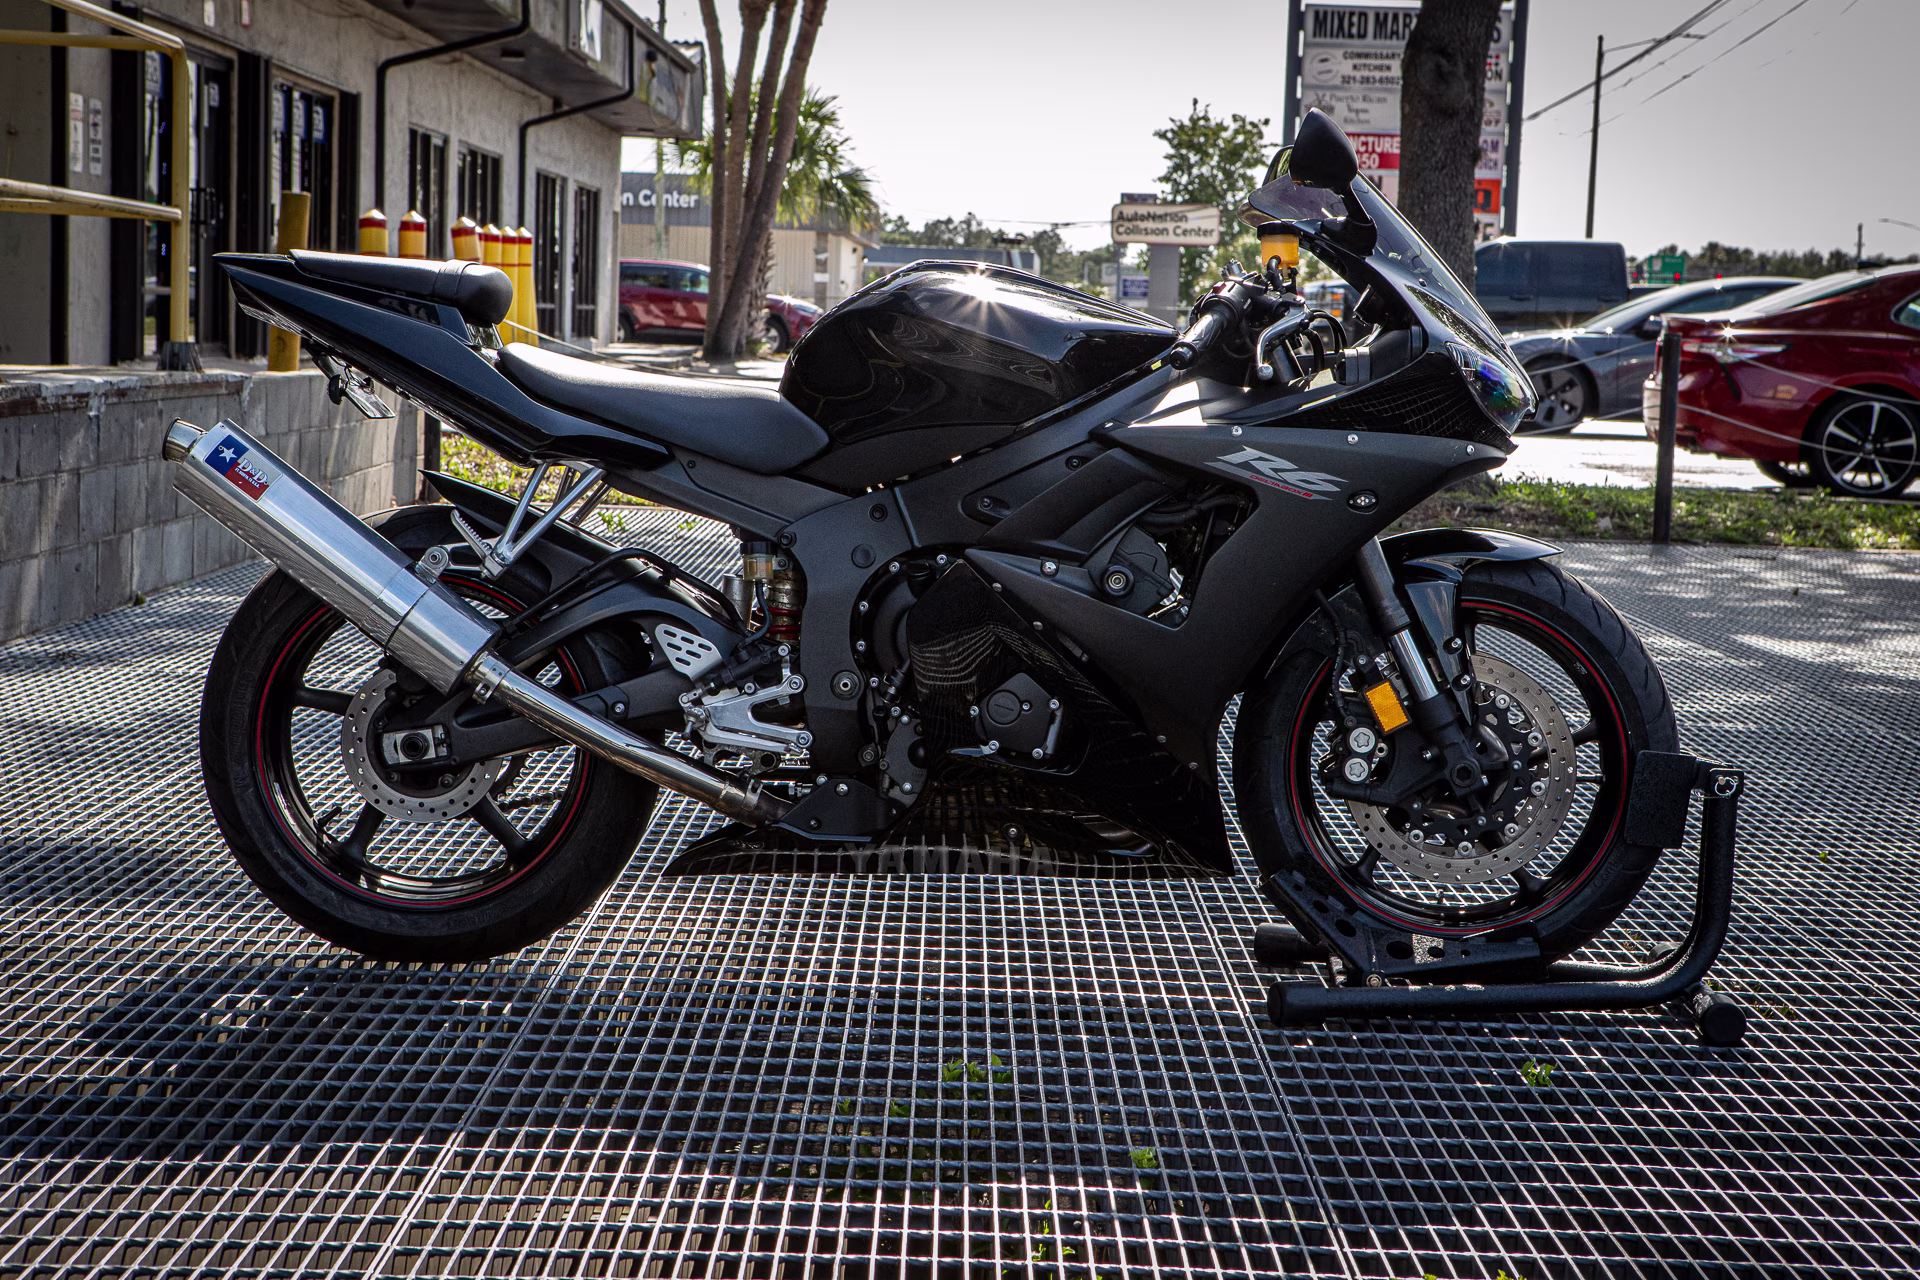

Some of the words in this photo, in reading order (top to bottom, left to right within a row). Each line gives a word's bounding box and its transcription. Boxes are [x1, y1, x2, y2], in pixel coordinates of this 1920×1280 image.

[1313, 9, 1368, 39] MIXED
[1373, 11, 1420, 41] MAR
[1342, 50, 1401, 60] COMMISSARY
[1352, 63, 1392, 72] KITCHEN
[1117, 210, 1189, 223] AutoNation
[1115, 224, 1169, 236] Collision
[1172, 225, 1215, 237] Center
[1216, 445, 1349, 492] R6
[844, 842, 1056, 876] YAMAHA
